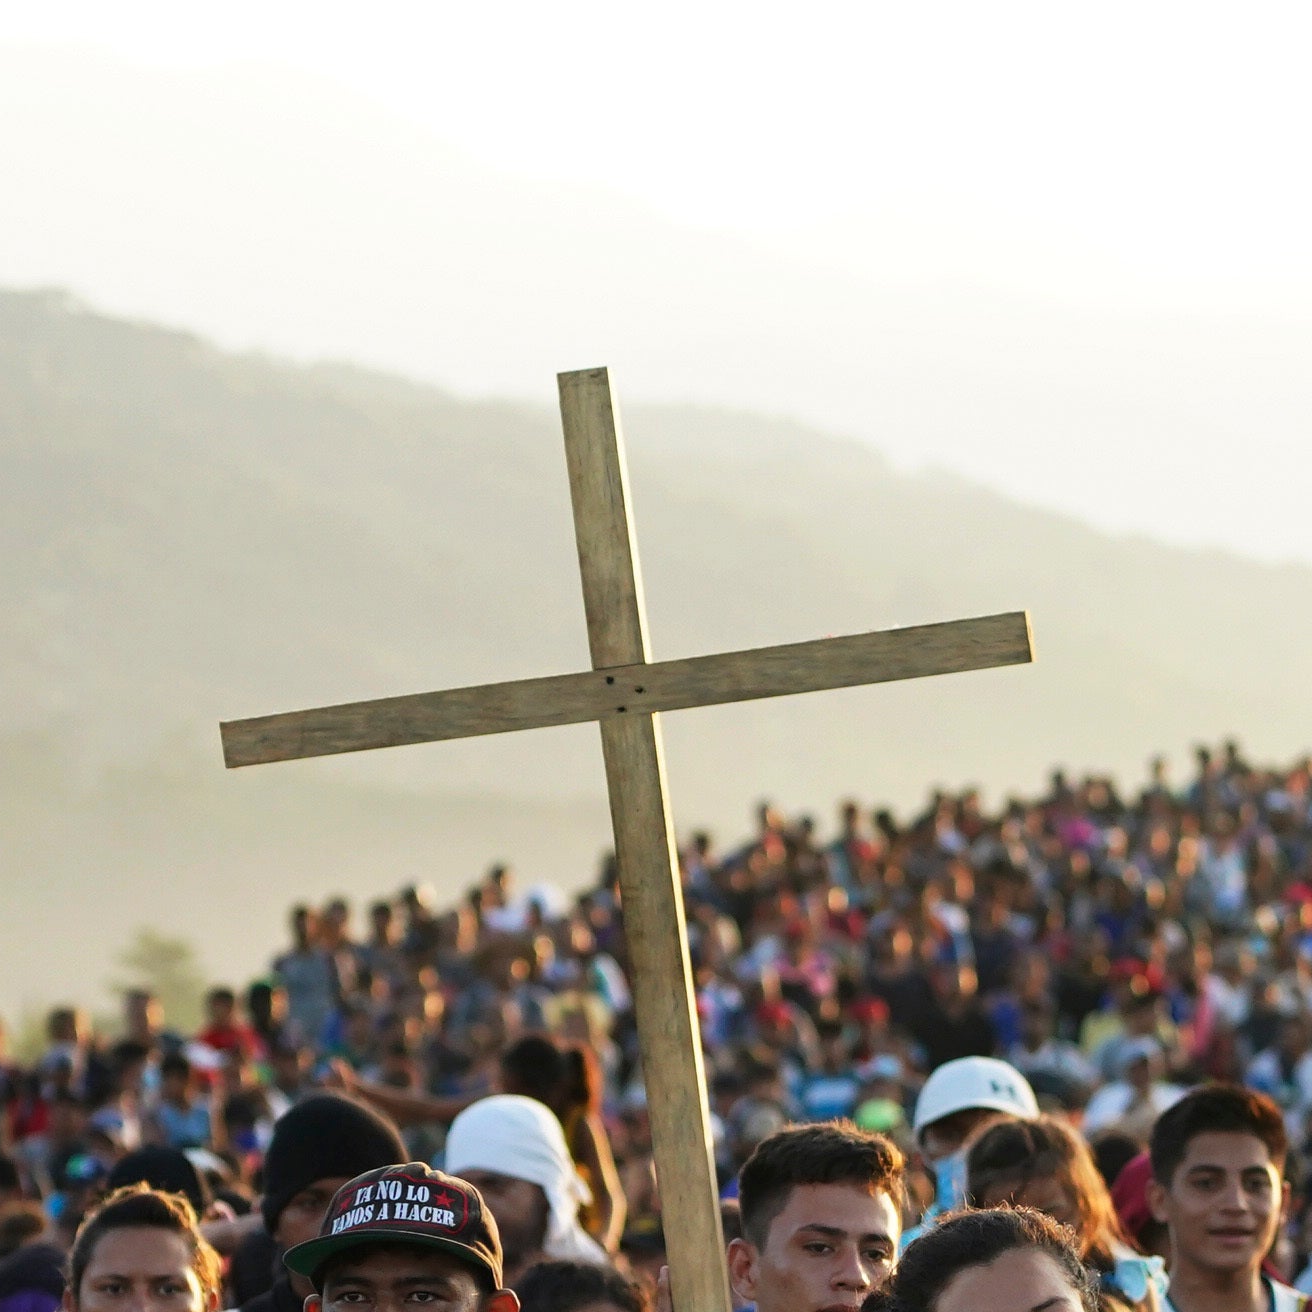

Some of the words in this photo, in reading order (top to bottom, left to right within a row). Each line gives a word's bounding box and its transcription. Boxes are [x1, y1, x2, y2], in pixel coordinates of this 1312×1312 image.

[375, 1180, 402, 1201] NO
[406, 1184, 430, 1203] LO
[331, 1204, 374, 1235] VAMOS
[376, 1203, 388, 1221] A
[393, 1202, 456, 1227] HACER
